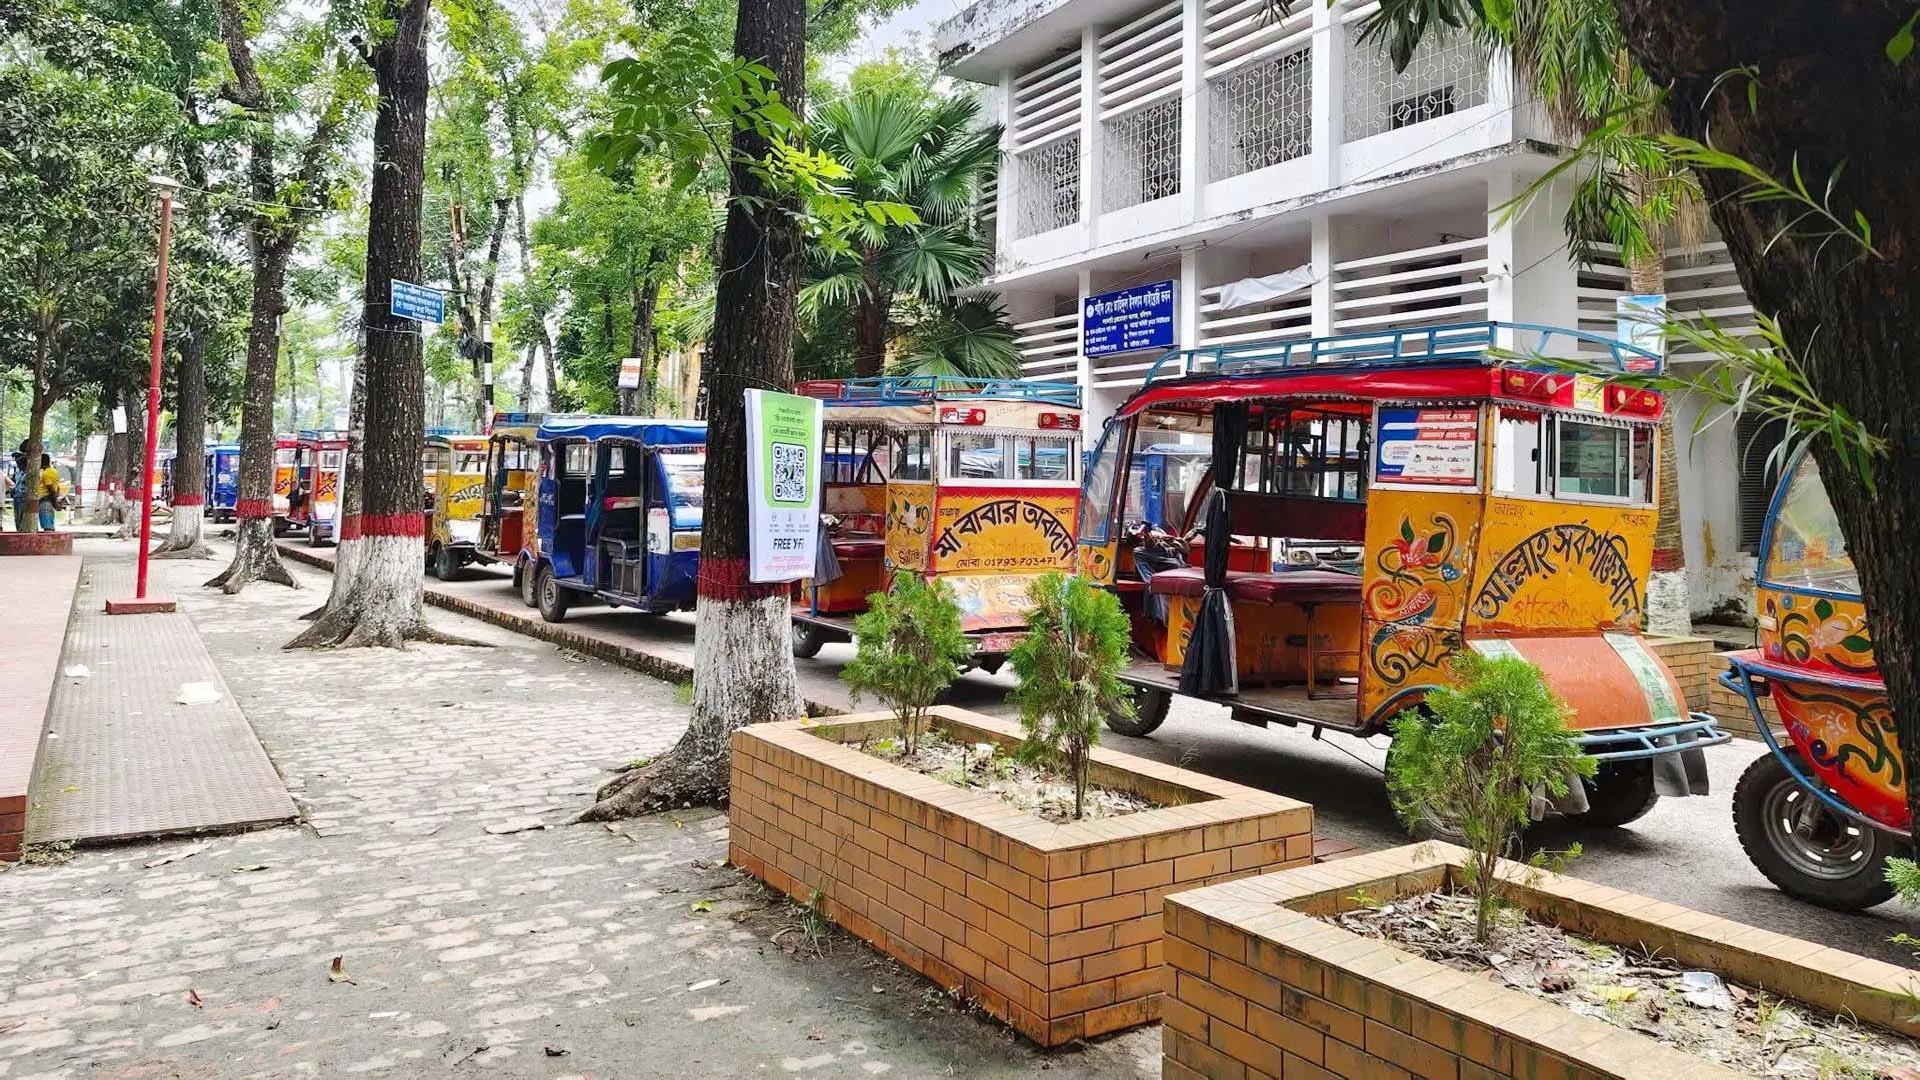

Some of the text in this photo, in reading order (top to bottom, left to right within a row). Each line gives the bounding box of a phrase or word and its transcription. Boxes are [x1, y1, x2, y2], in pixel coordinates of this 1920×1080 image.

[773, 538, 792, 550] FREE
[934, 527, 962, 558] মা
[952, 500, 1022, 535] বাবার
[1022, 501, 1077, 561] অবদান
